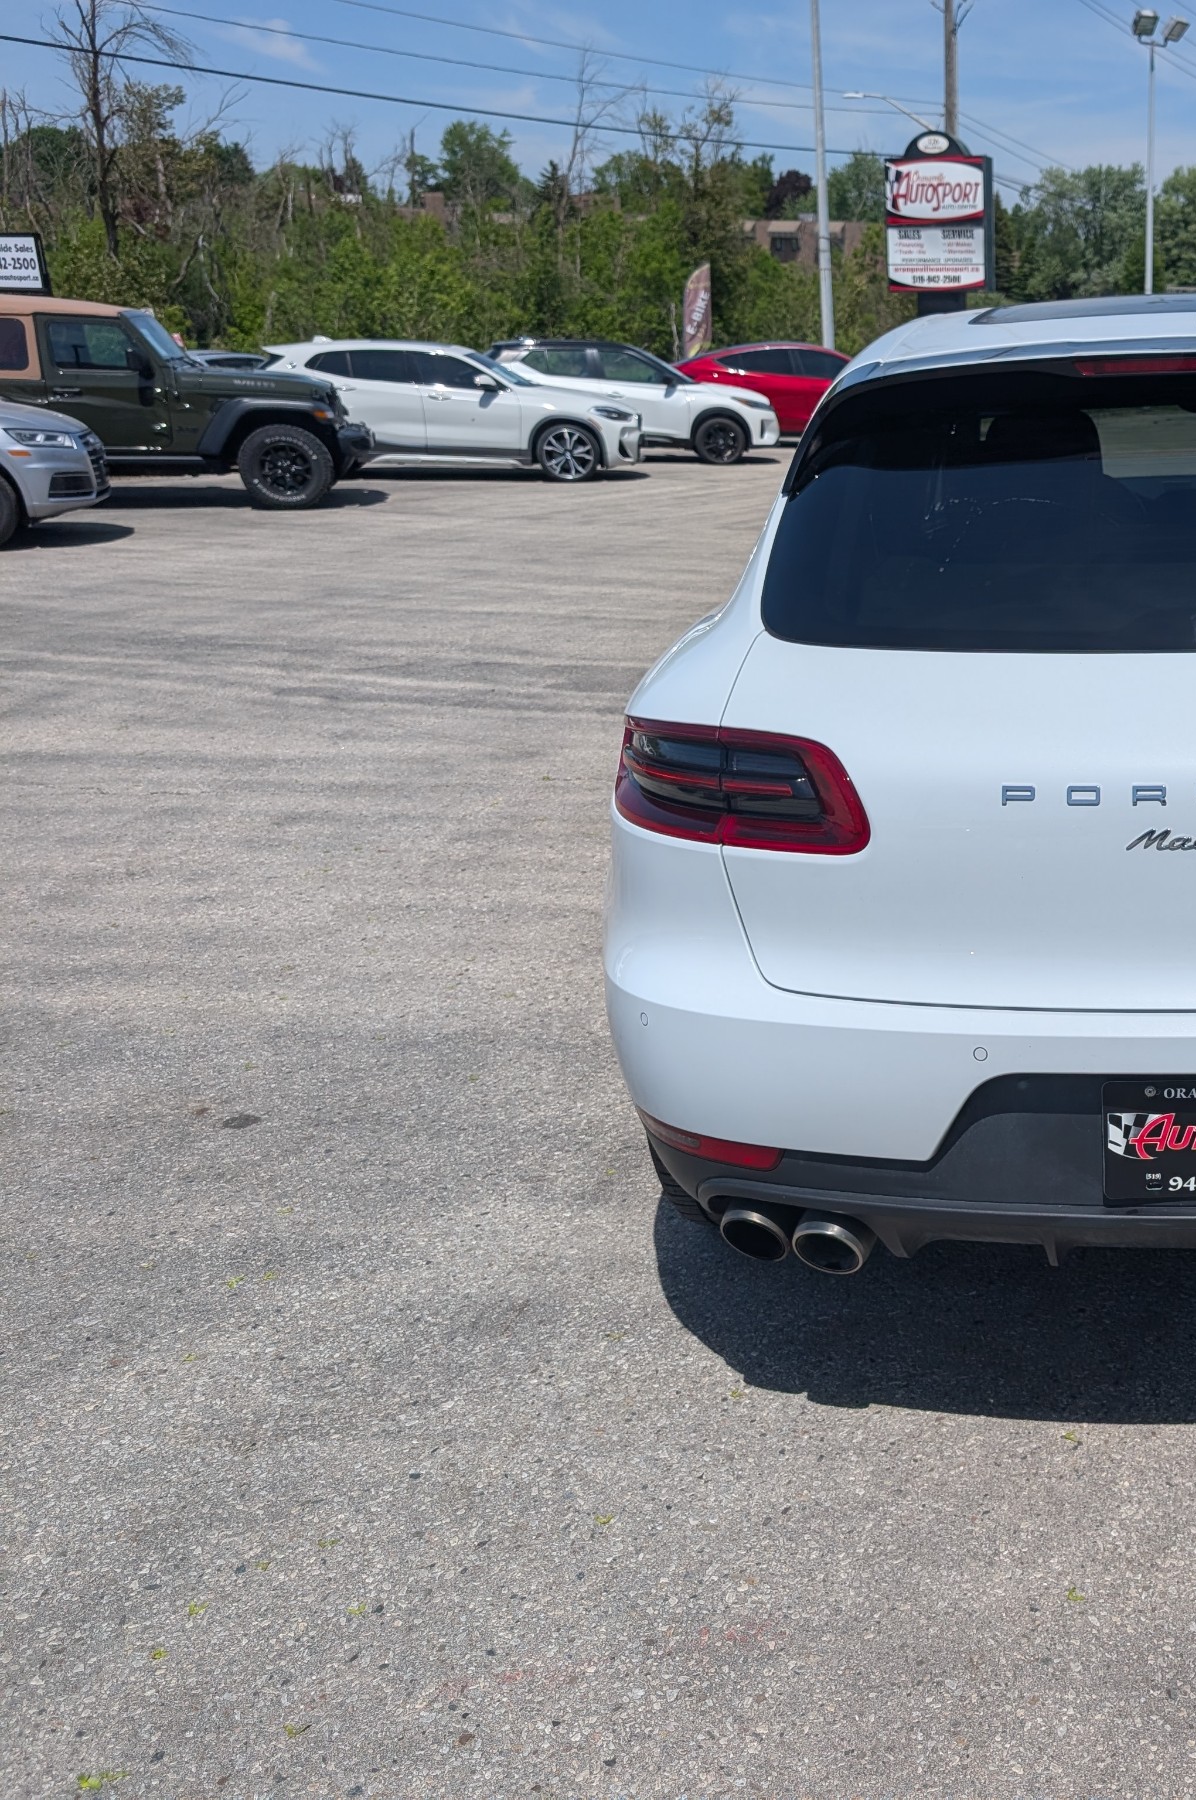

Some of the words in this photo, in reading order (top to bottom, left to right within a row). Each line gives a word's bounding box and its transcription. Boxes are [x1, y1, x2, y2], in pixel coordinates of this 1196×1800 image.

[893, 171, 980, 212] AUTOSPORT
[14, 244, 33, 253] Sales
[686, 290, 710, 335] E-BIKE
[1145, 1172, 1162, 1180] (519)
